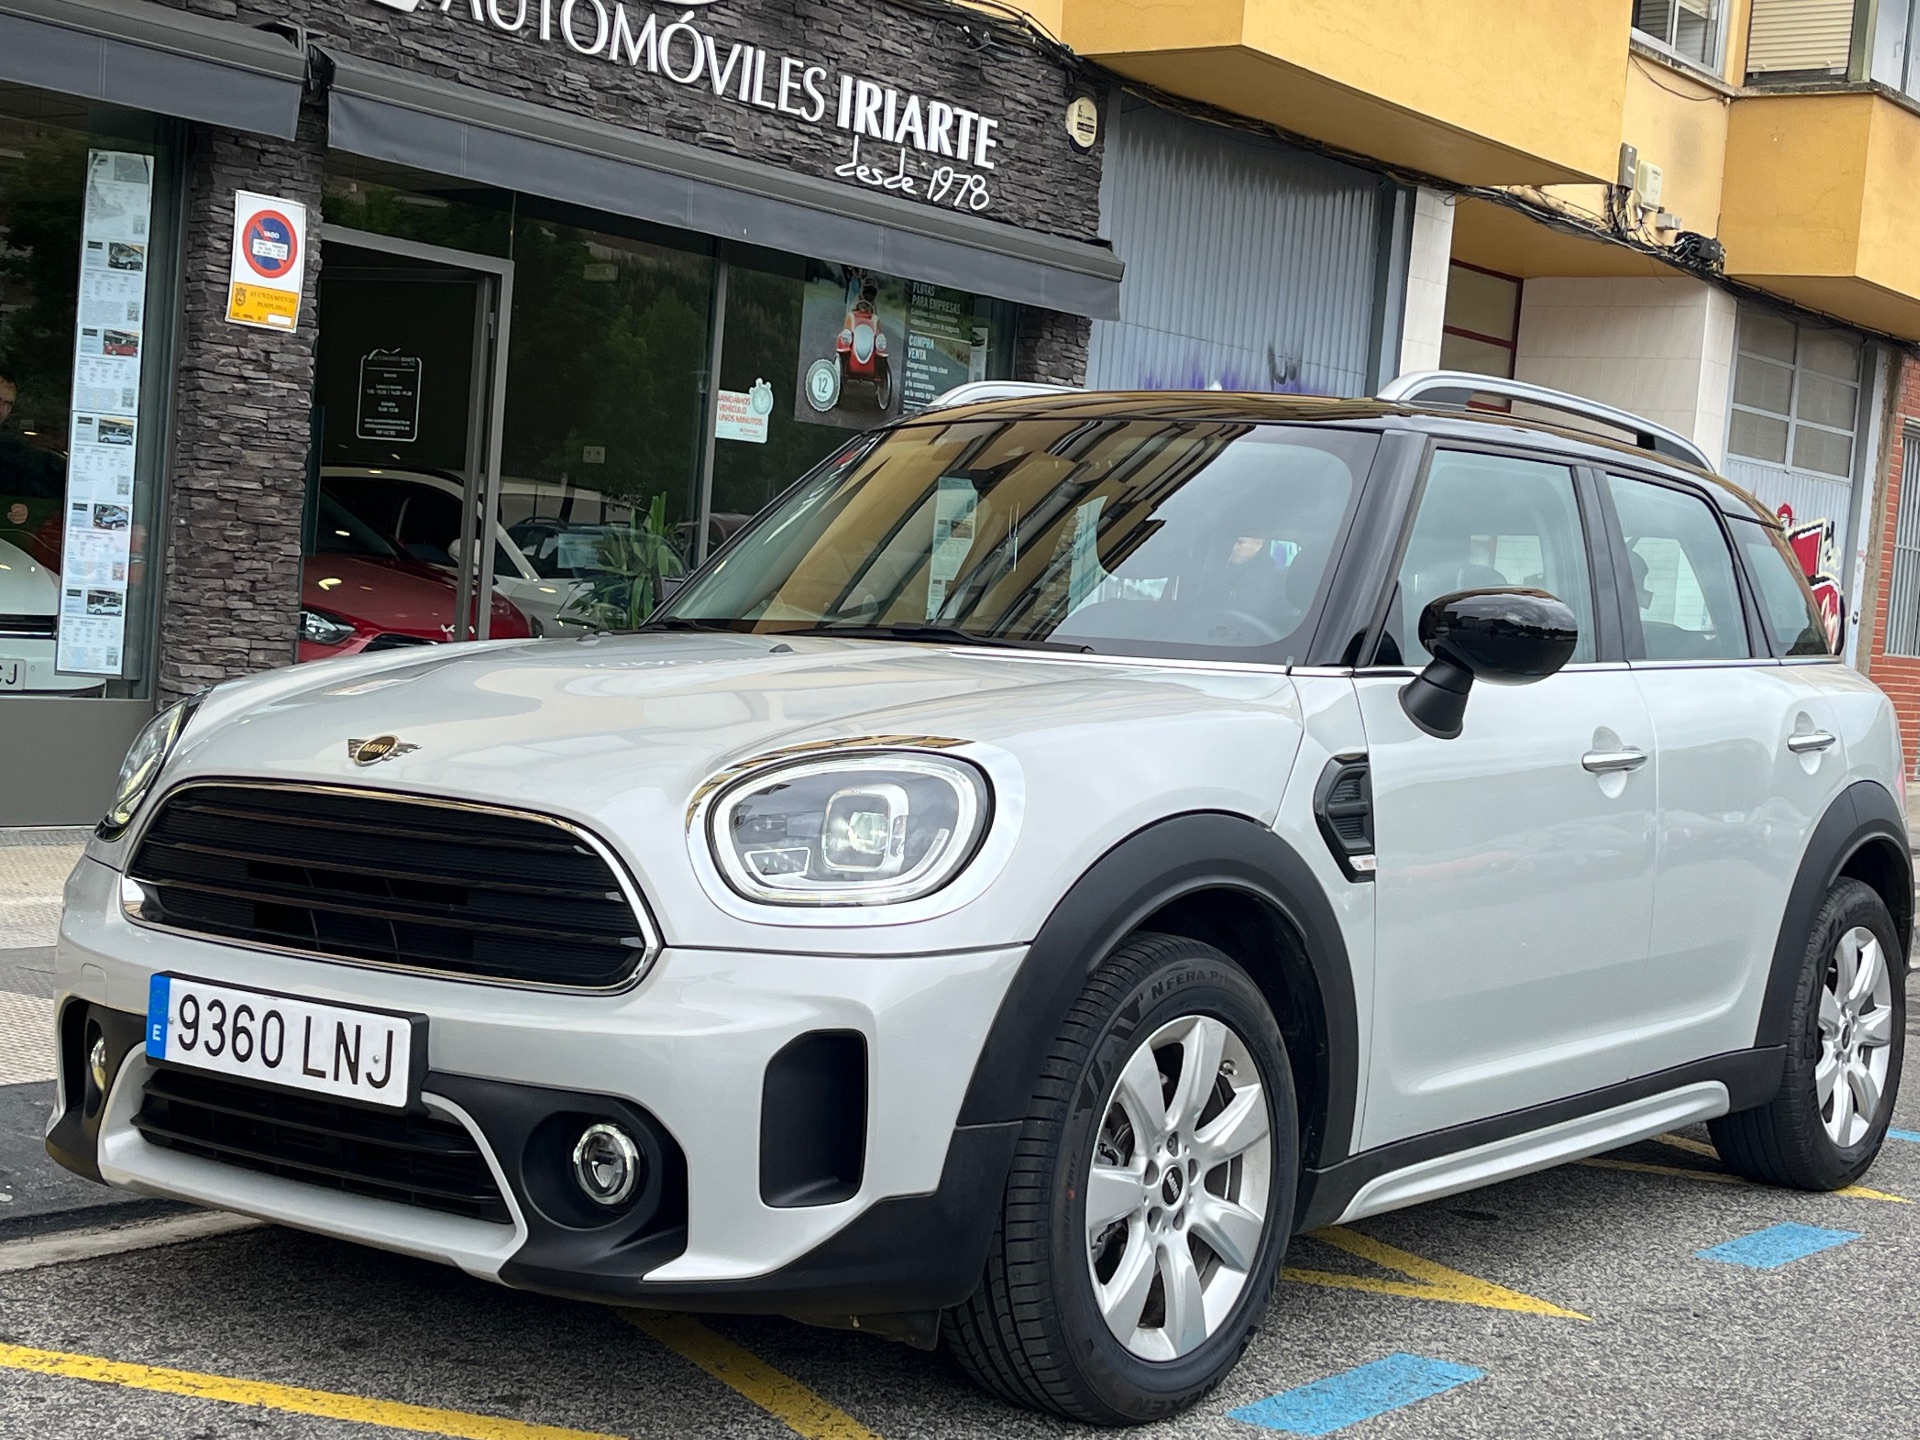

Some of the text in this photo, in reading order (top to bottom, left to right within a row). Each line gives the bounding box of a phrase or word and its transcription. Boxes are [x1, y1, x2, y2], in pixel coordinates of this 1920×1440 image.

[837, 75, 998, 170] IRIARTE
[834, 135, 989, 210] desde 1978
[913, 281, 936, 297] FLOTAS
[911, 294, 961, 315] PARA EMPRESAS
[908, 334, 934, 350] COMPRA
[907, 347, 927, 361] VENTA
[818, 377, 828, 393] 12
[0, 663, 17, 685] J
[362, 743, 391, 754] MINI
[152, 994, 394, 1089] E 9360 LNJ
